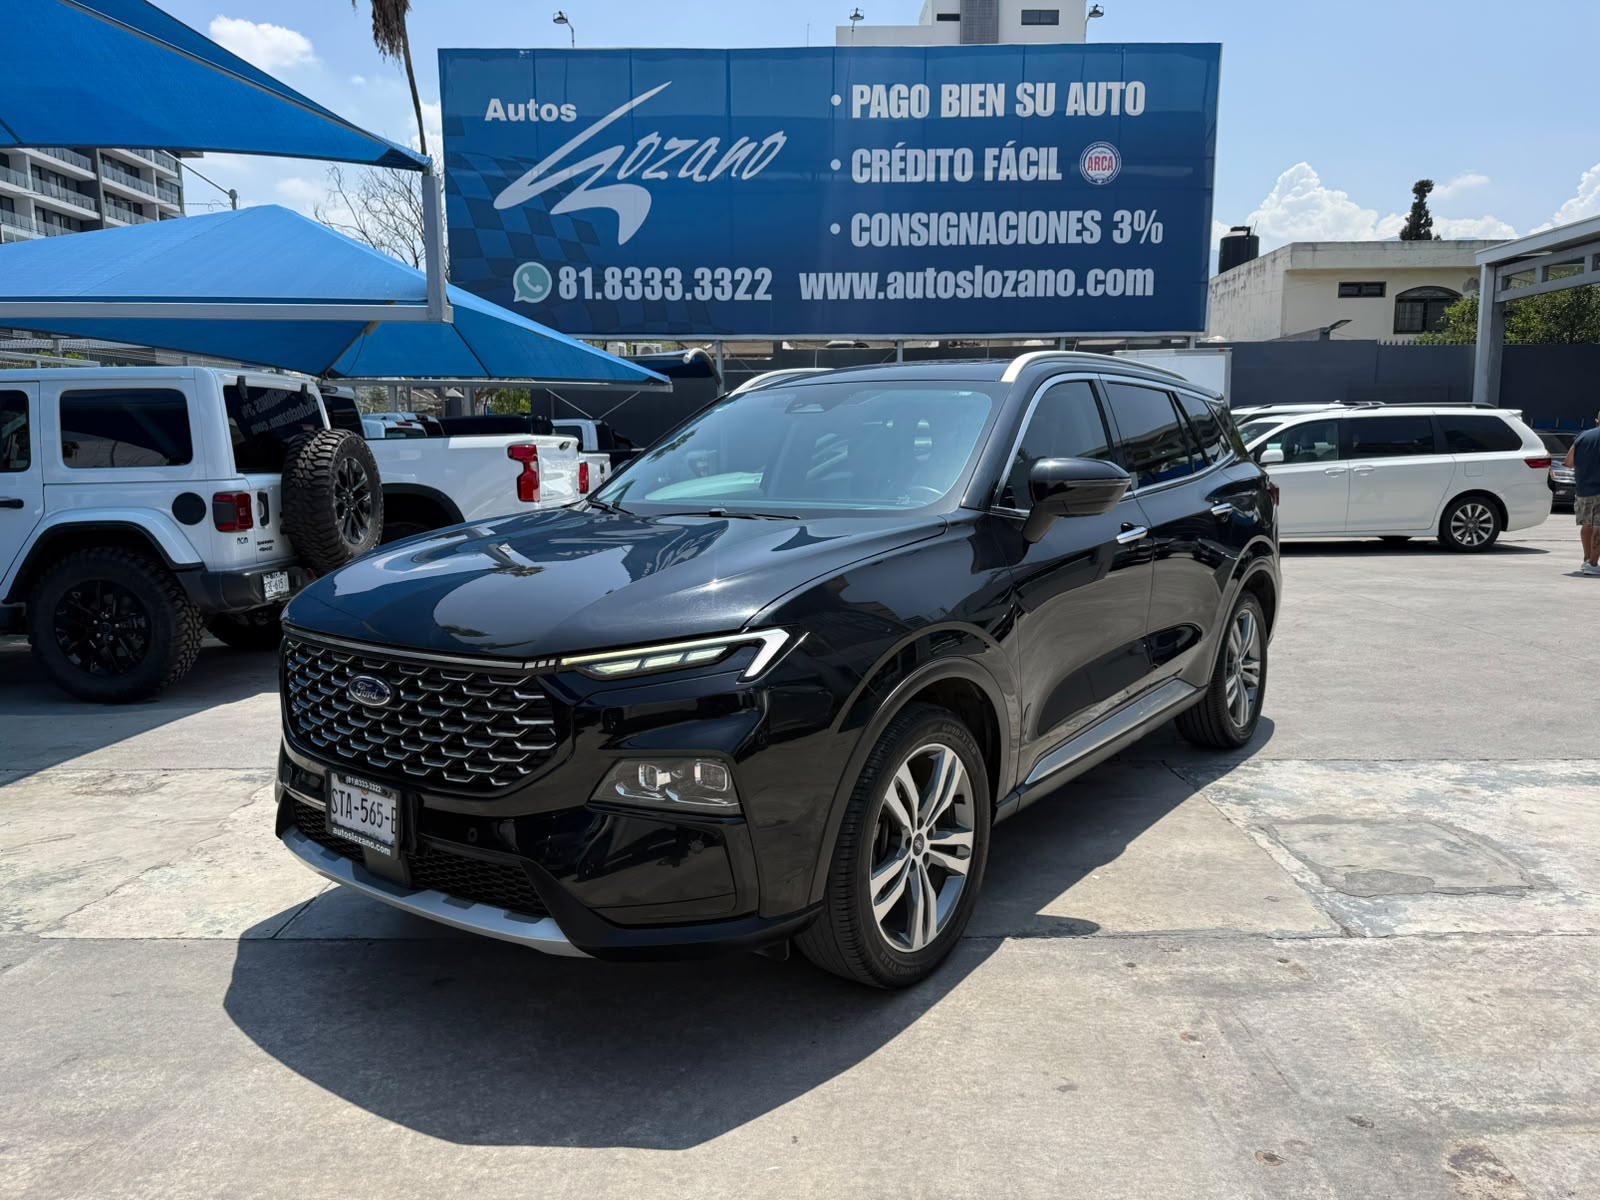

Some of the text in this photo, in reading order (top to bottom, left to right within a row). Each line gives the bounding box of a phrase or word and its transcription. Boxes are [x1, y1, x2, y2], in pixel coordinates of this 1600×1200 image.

[484, 98, 577, 122] Autos
[851, 80, 1146, 119] PAGO BIEN SU AUTO
[851, 140, 1063, 184] CRÉDITO FÁCIL
[1086, 155, 1114, 172] ARCA
[850, 208, 1164, 247] CONSIGNACIONES 3%
[558, 266, 773, 301] 81.8333.3322
[798, 265, 1155, 301] www.autoslozano.com
[355, 681, 379, 701] Ford
[332, 827, 391, 857] autoslozano.com
